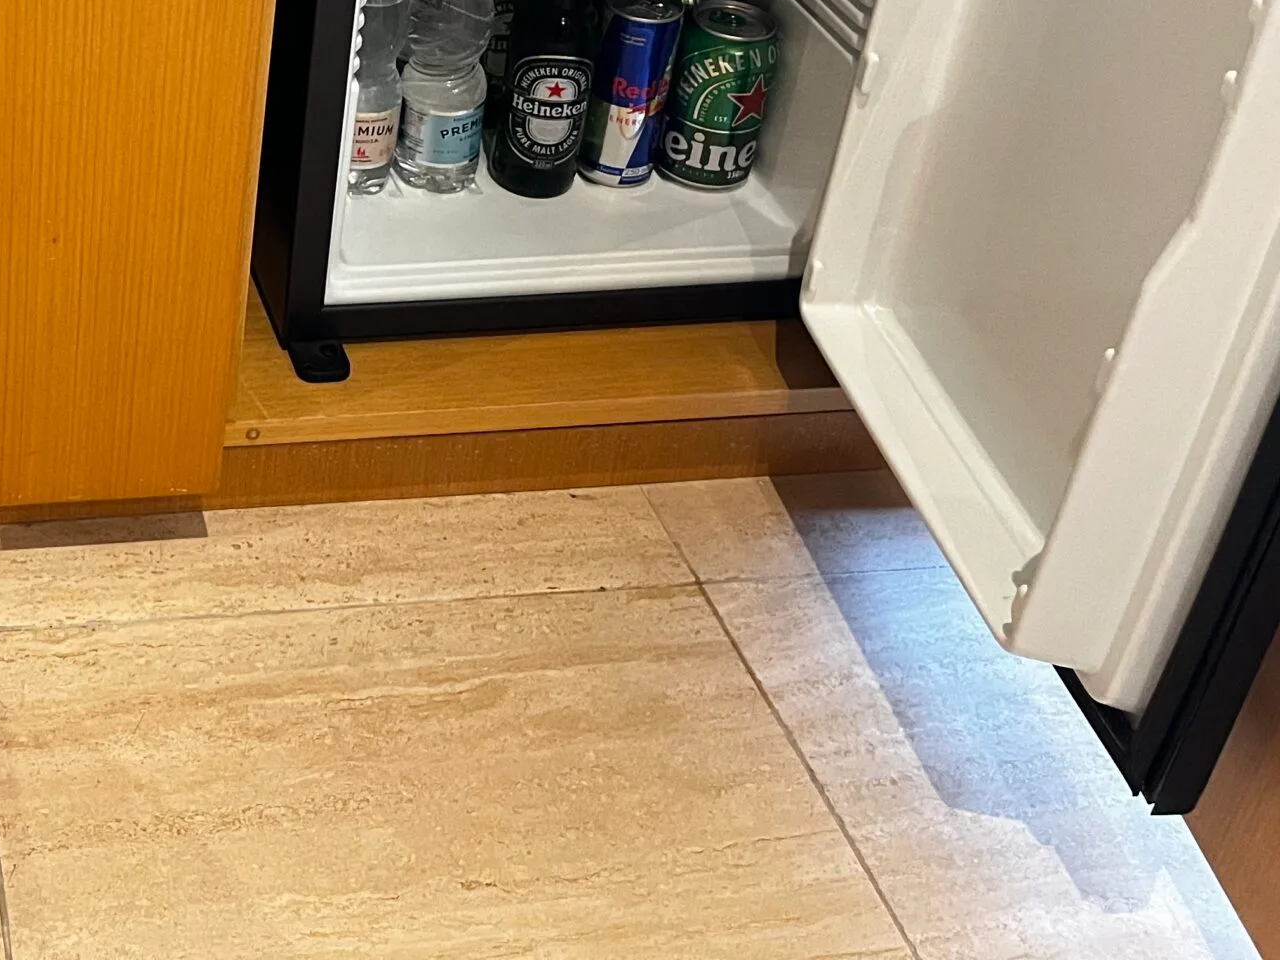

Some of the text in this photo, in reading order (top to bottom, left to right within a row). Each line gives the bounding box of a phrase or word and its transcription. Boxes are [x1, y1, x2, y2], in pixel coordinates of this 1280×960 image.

[520, 67, 587, 92] HEINEKEN ORIGINAL
[612, 77, 656, 99] Red
[512, 93, 587, 118] Heineken
[515, 127, 579, 155] PURE MALT LAGER
